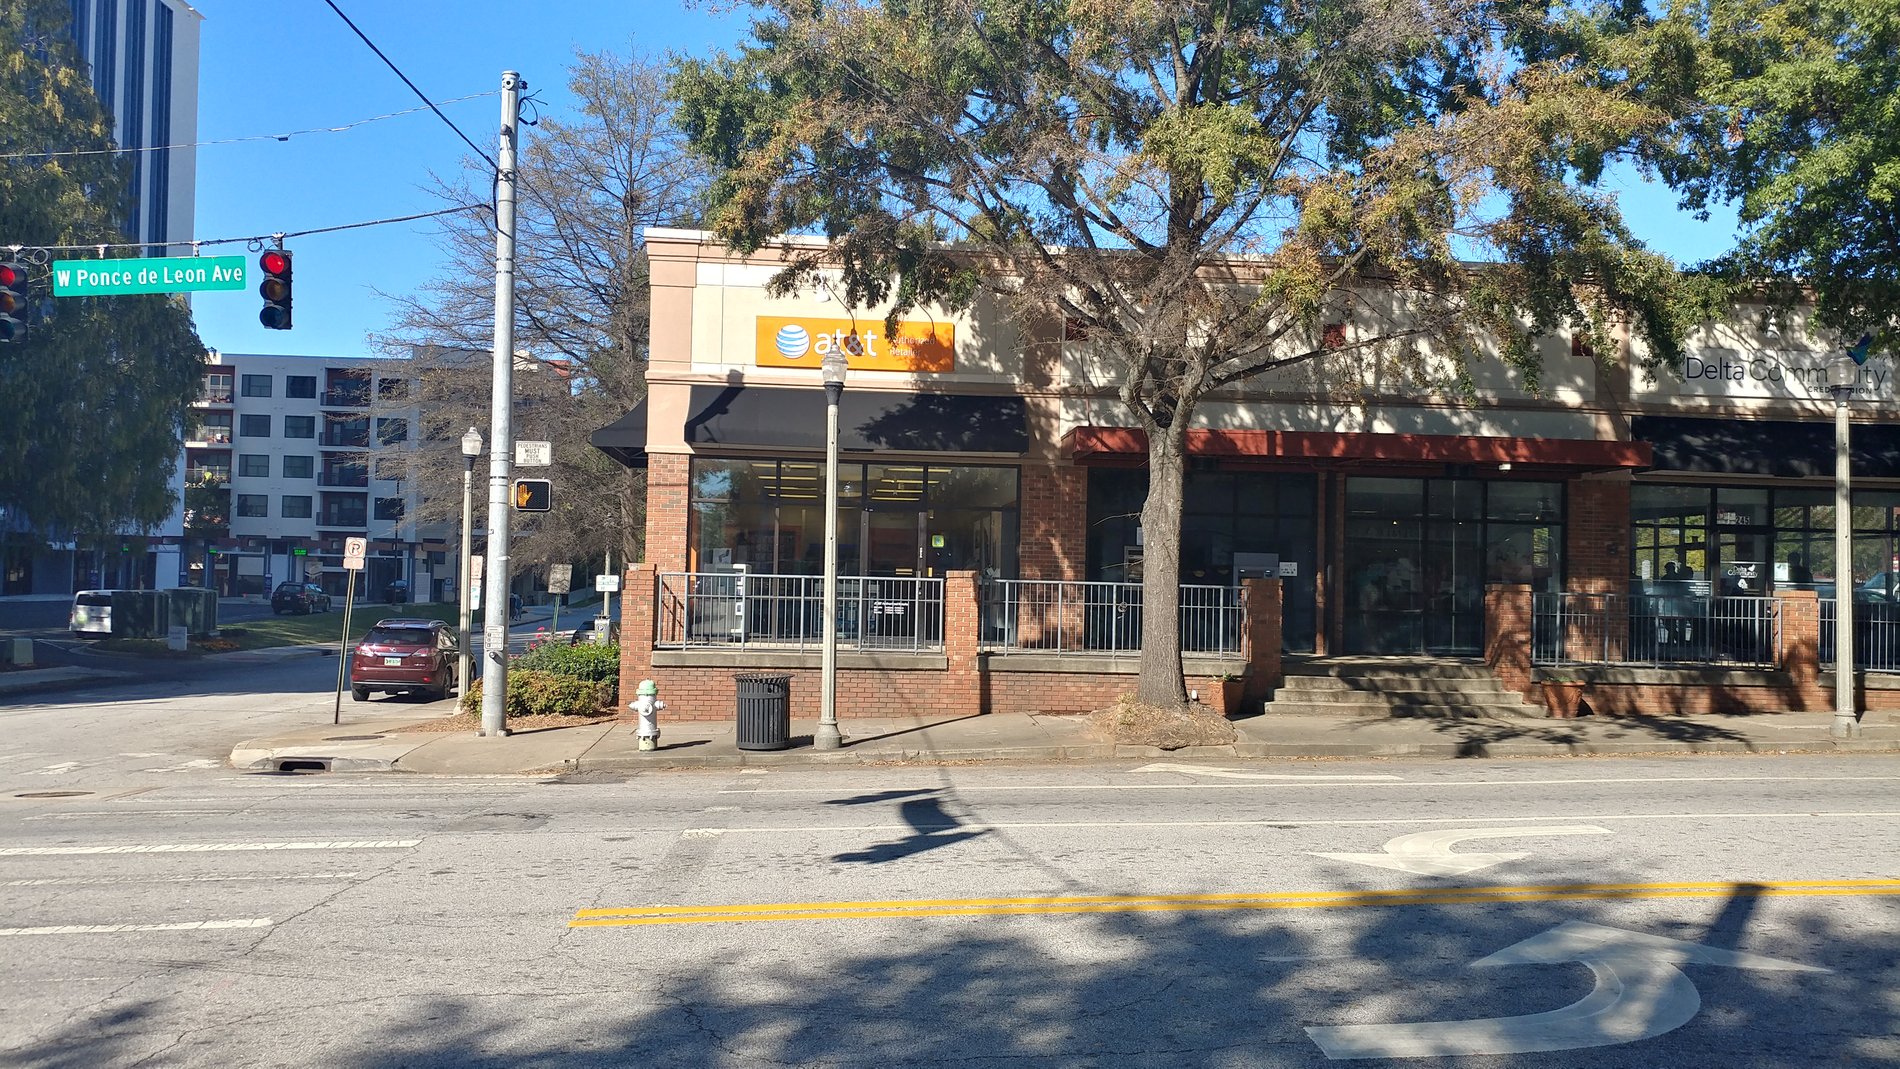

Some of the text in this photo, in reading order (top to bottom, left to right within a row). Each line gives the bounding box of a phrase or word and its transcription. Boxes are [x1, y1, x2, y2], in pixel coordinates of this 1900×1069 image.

[57, 265, 243, 287] W Ponce de Leon Ave
[890, 335, 936, 345] uthorized
[1685, 356, 1887, 390] Delta Commity
